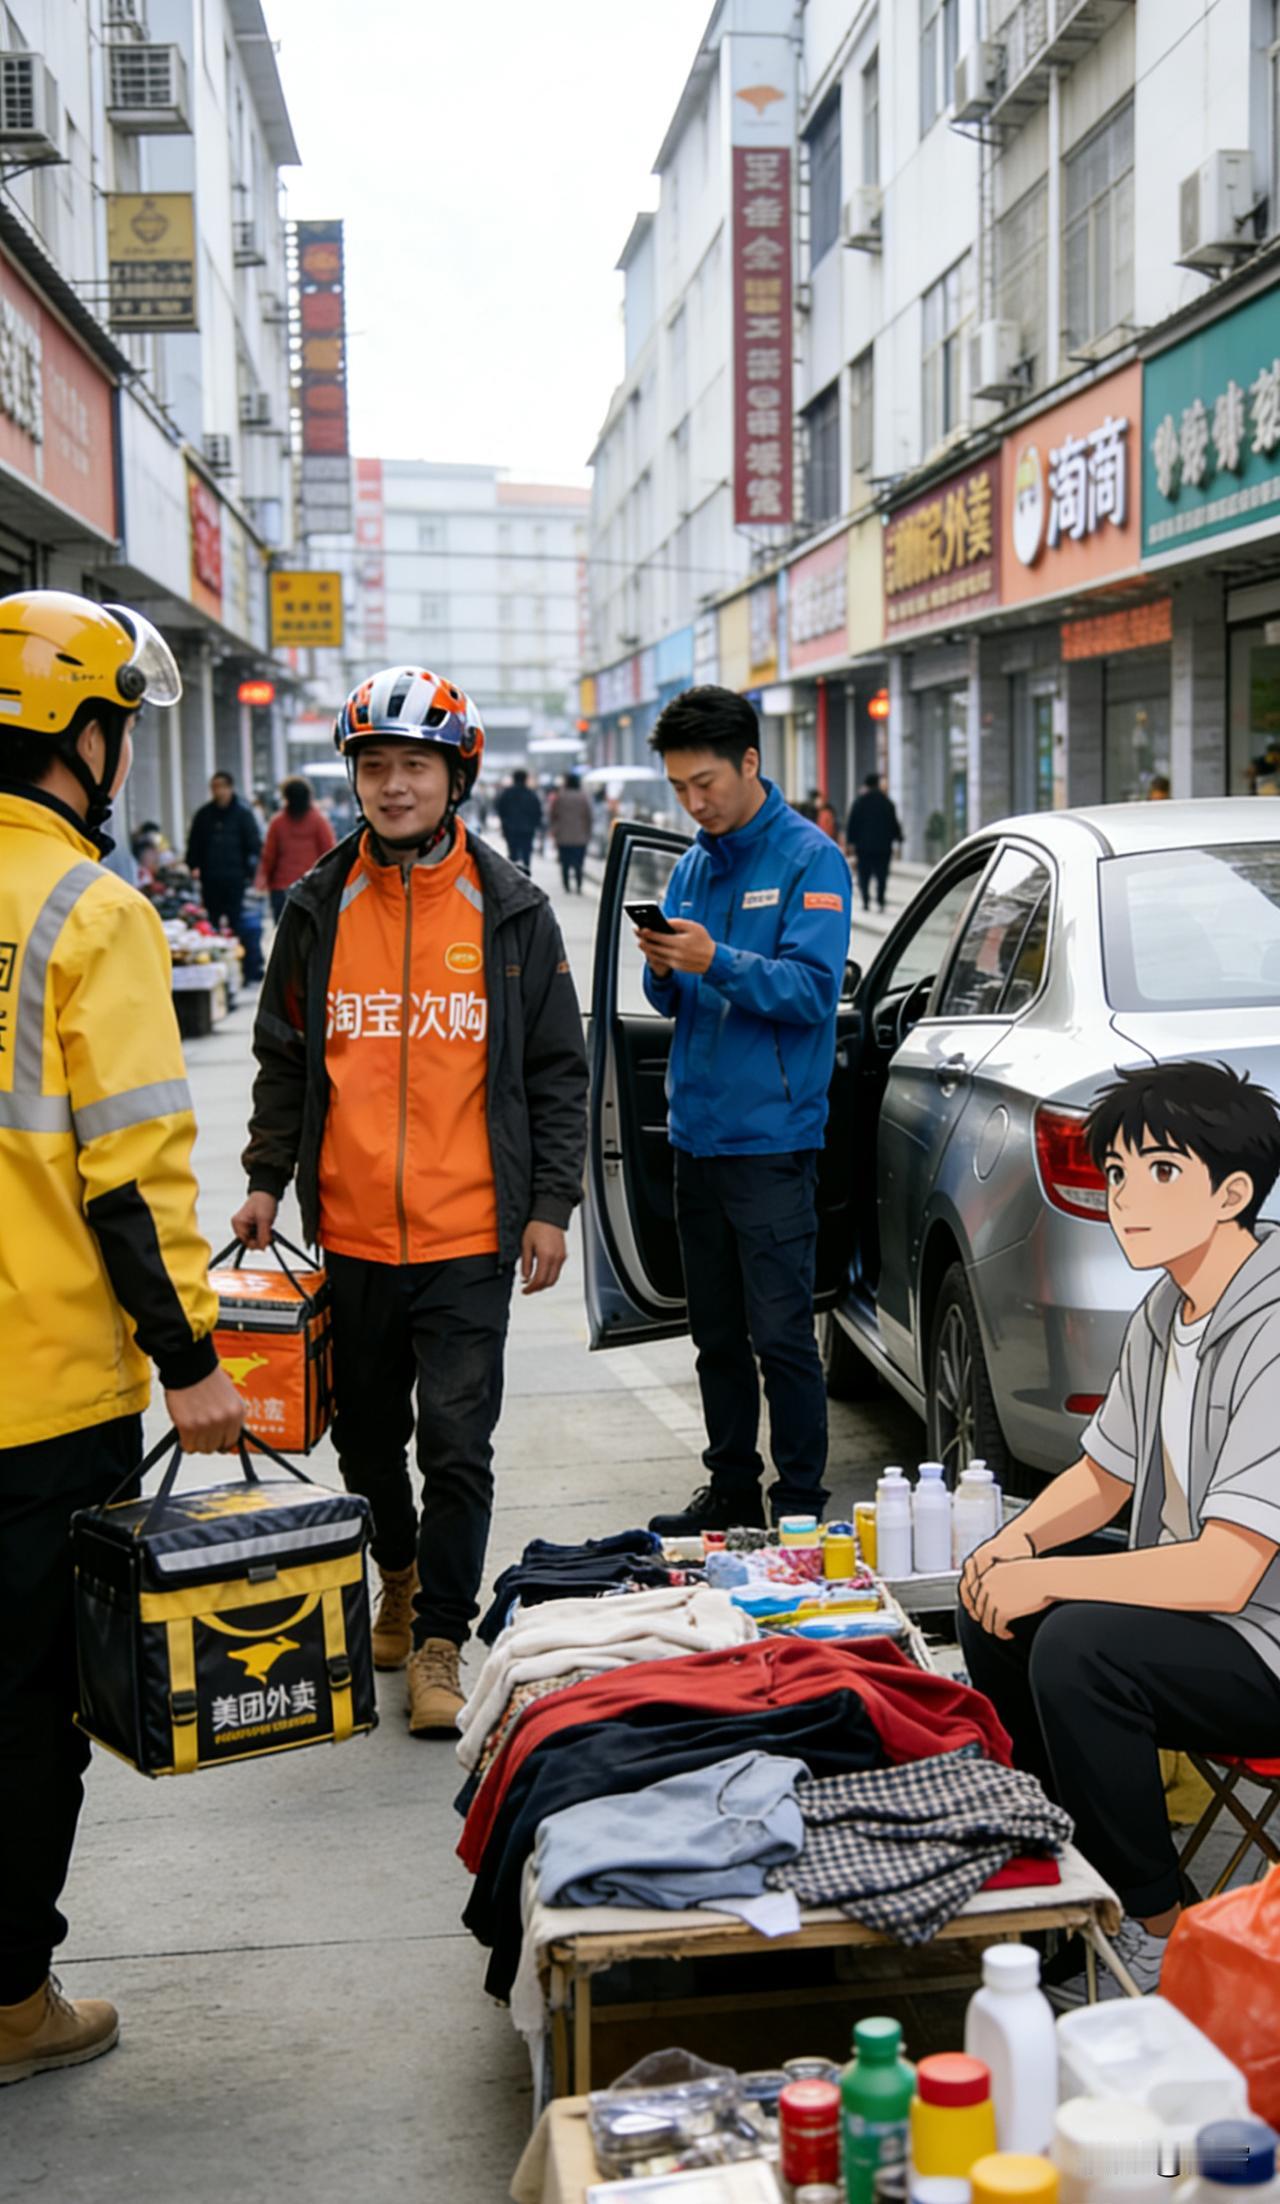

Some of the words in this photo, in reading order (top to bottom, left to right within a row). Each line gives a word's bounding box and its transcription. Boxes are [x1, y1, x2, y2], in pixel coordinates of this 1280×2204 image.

[326, 988, 488, 1043] 淘宝次购
[212, 1679, 317, 1732] 美团外卖
